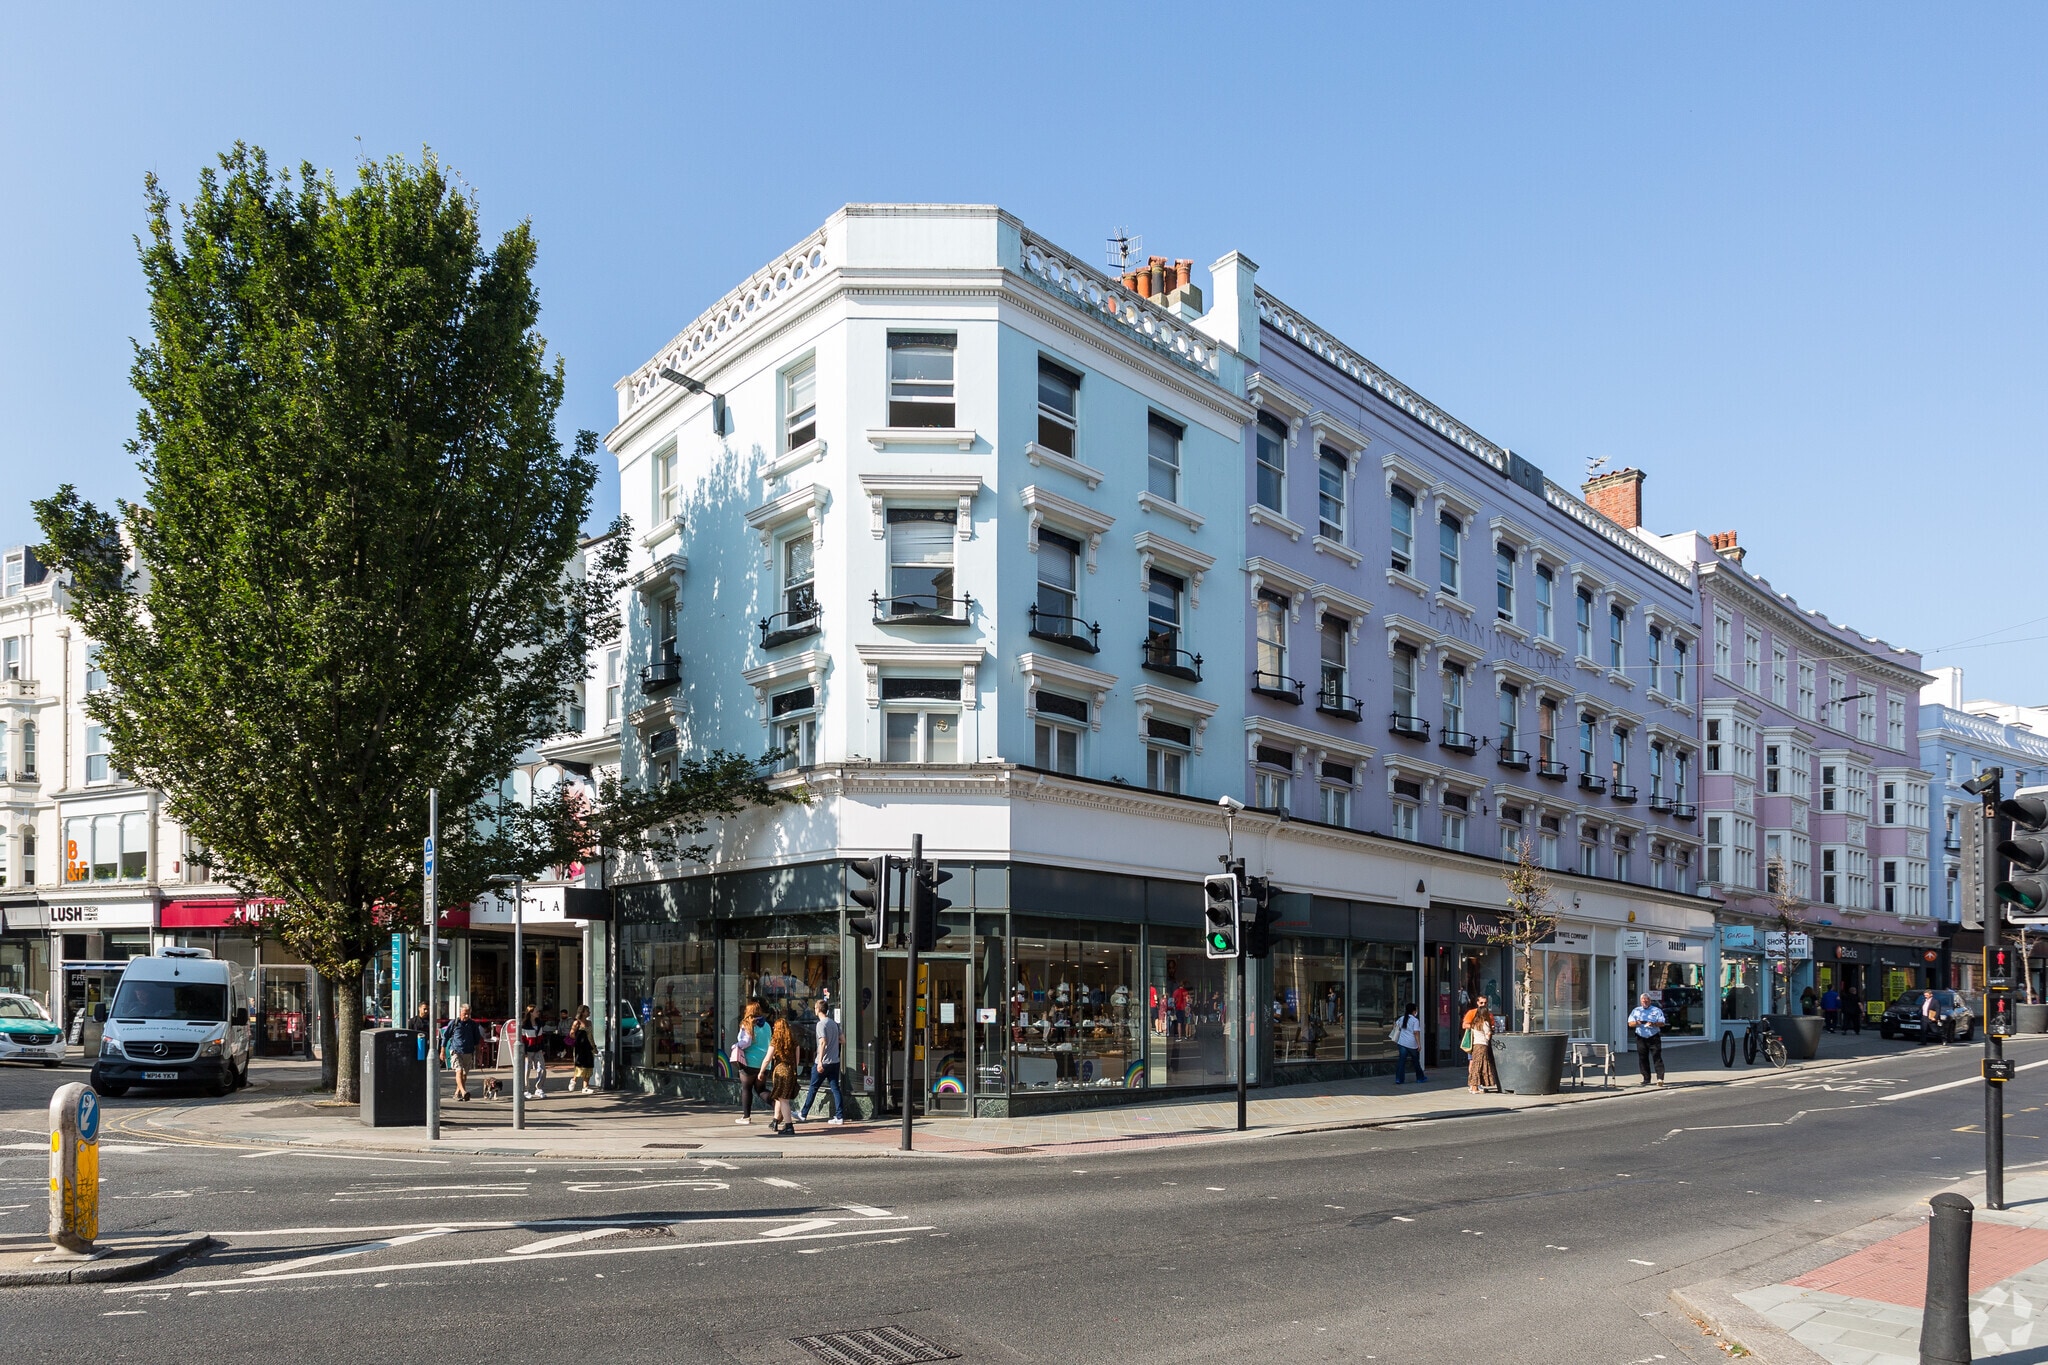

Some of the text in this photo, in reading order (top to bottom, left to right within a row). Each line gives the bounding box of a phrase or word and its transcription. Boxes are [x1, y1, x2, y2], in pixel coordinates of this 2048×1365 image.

[1427, 602, 1571, 681] HANNINGTONS
[68, 839, 78, 860] B
[51, 907, 82, 921] LUSH
[1842, 946, 1858, 958] Blacks
